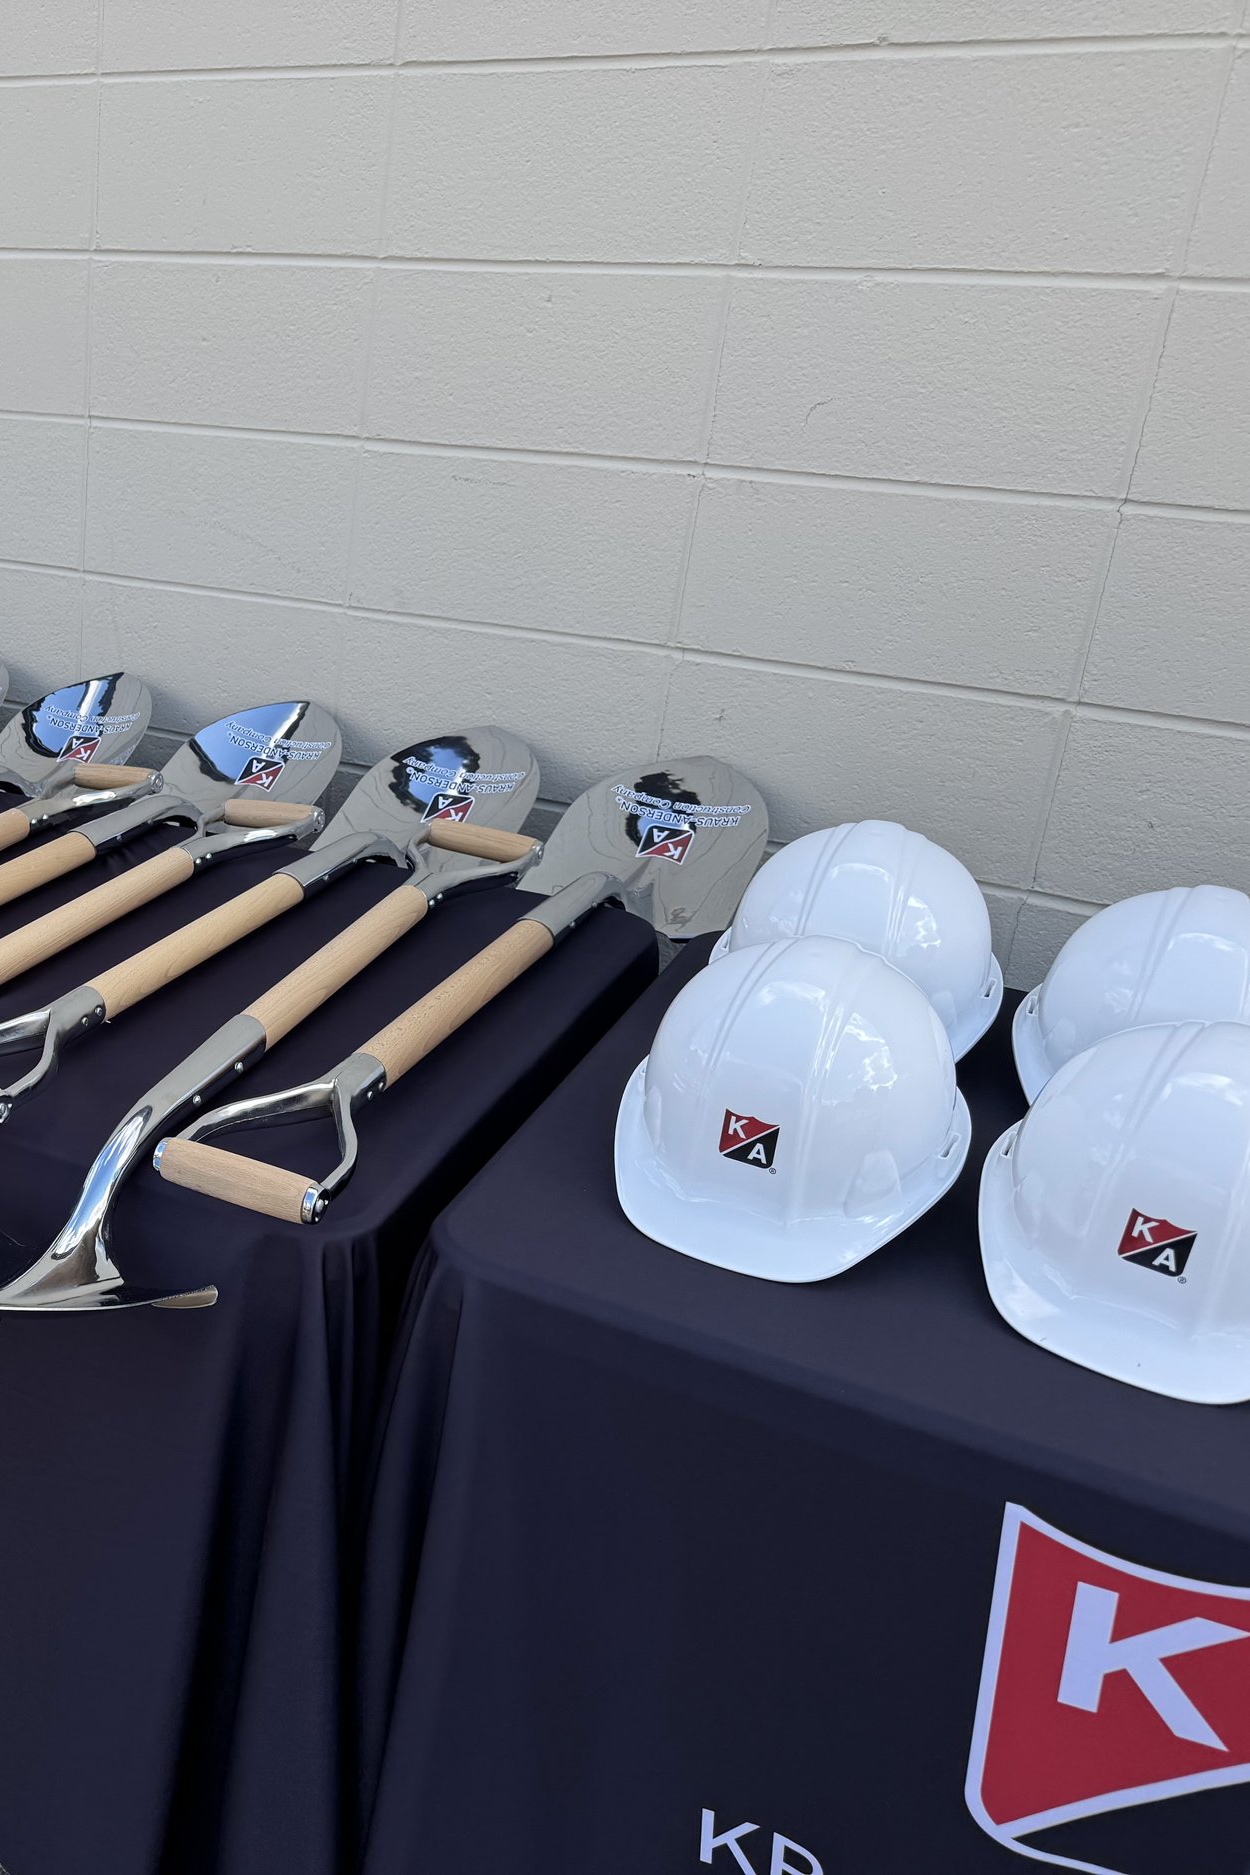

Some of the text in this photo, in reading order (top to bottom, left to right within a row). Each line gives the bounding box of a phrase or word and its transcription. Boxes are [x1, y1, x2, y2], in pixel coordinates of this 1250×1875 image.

[44, 705, 89, 723] Company
[224, 720, 272, 744] Company
[71, 738, 82, 749] A
[75, 748, 92, 761] K
[251, 759, 266, 773] A
[403, 756, 526, 783] Construction Company
[256, 773, 275, 788] K
[438, 796, 454, 810] A
[611, 784, 752, 815] Construction Company
[444, 809, 464, 822] K
[652, 828, 670, 843] A
[662, 842, 684, 860] K
[728, 1115, 750, 1140] K
[747, 1142, 767, 1164] A
[1131, 1216, 1160, 1243] K
[1152, 1247, 1177, 1273] A
[1057, 1580, 1250, 1753] K
